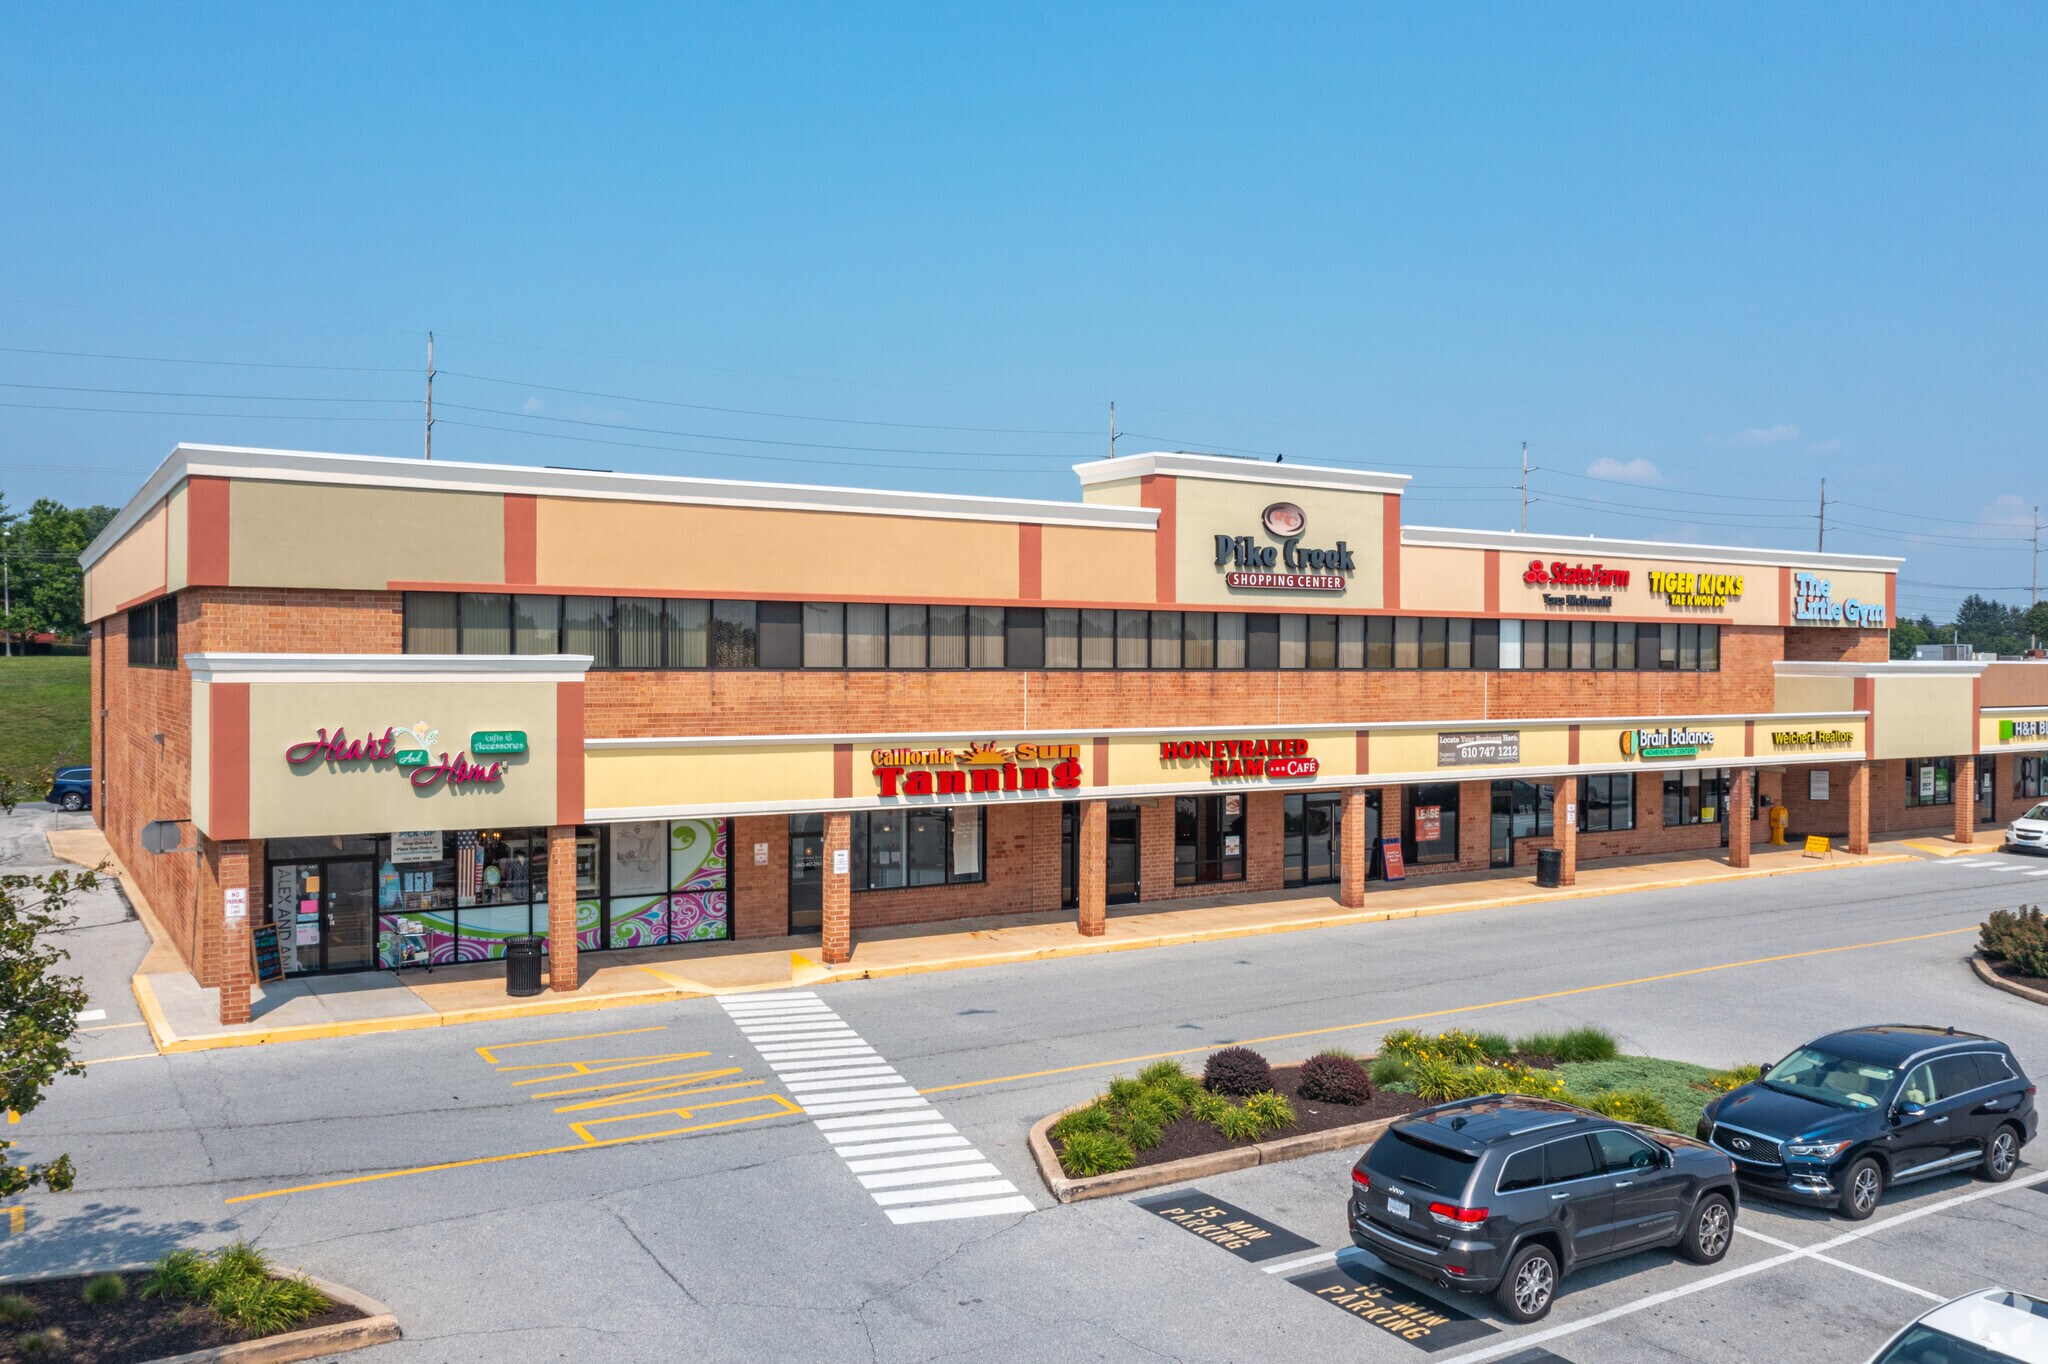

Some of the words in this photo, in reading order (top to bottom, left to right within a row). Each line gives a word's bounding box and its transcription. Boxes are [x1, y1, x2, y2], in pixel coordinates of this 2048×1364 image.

[1214, 534, 1278, 568] Pike
[1283, 538, 1355, 571] Creek
[1233, 573, 1294, 588] SHOPPING
[1297, 576, 1341, 589] CENTER
[1649, 571, 1696, 595] TIGER
[1697, 574, 1744, 596] KICKS
[1795, 572, 1831, 597] The
[1566, 595, 1612, 608] McDonald
[1670, 594, 1686, 606] TAE
[1687, 595, 1712, 607] KWON
[1713, 596, 1727, 608] DO
[1795, 596, 1843, 621] Little
[1844, 598, 1886, 627] Gym
[485, 733, 505, 744] Gifts
[1475, 735, 1502, 743] Business
[1638, 729, 1668, 747] Brain
[1670, 727, 1714, 745] Balance
[1817, 730, 1854, 744] Realtors
[2014, 721, 2037, 737] H&R
[285, 726, 396, 764] Heart
[474, 740, 525, 752] Accessories
[872, 747, 955, 767] California
[1015, 743, 1081, 761] Sun
[1160, 739, 1309, 760] HONEYBAKED
[1461, 747, 1478, 758] 610
[1479, 746, 1496, 757] 747
[1498, 745, 1519, 757] 1212
[399, 751, 423, 764] And
[1287, 759, 1316, 775] CAFÉ
[410, 751, 503, 787] Home
[874, 757, 1082, 798] Tanning
[1210, 759, 1265, 778] HAM
[1416, 808, 1440, 820] LEASE
[277, 868, 292, 905] ALEX
[277, 908, 292, 941] AND
[1158, 1207, 1252, 1250] PARKING
[1193, 1205, 1228, 1219] 15
[1222, 1219, 1273, 1240] MIN
[1316, 1284, 1431, 1340] PARKING
[1354, 1283, 1393, 1299] 15
[1392, 1301, 1451, 1327] MIN
